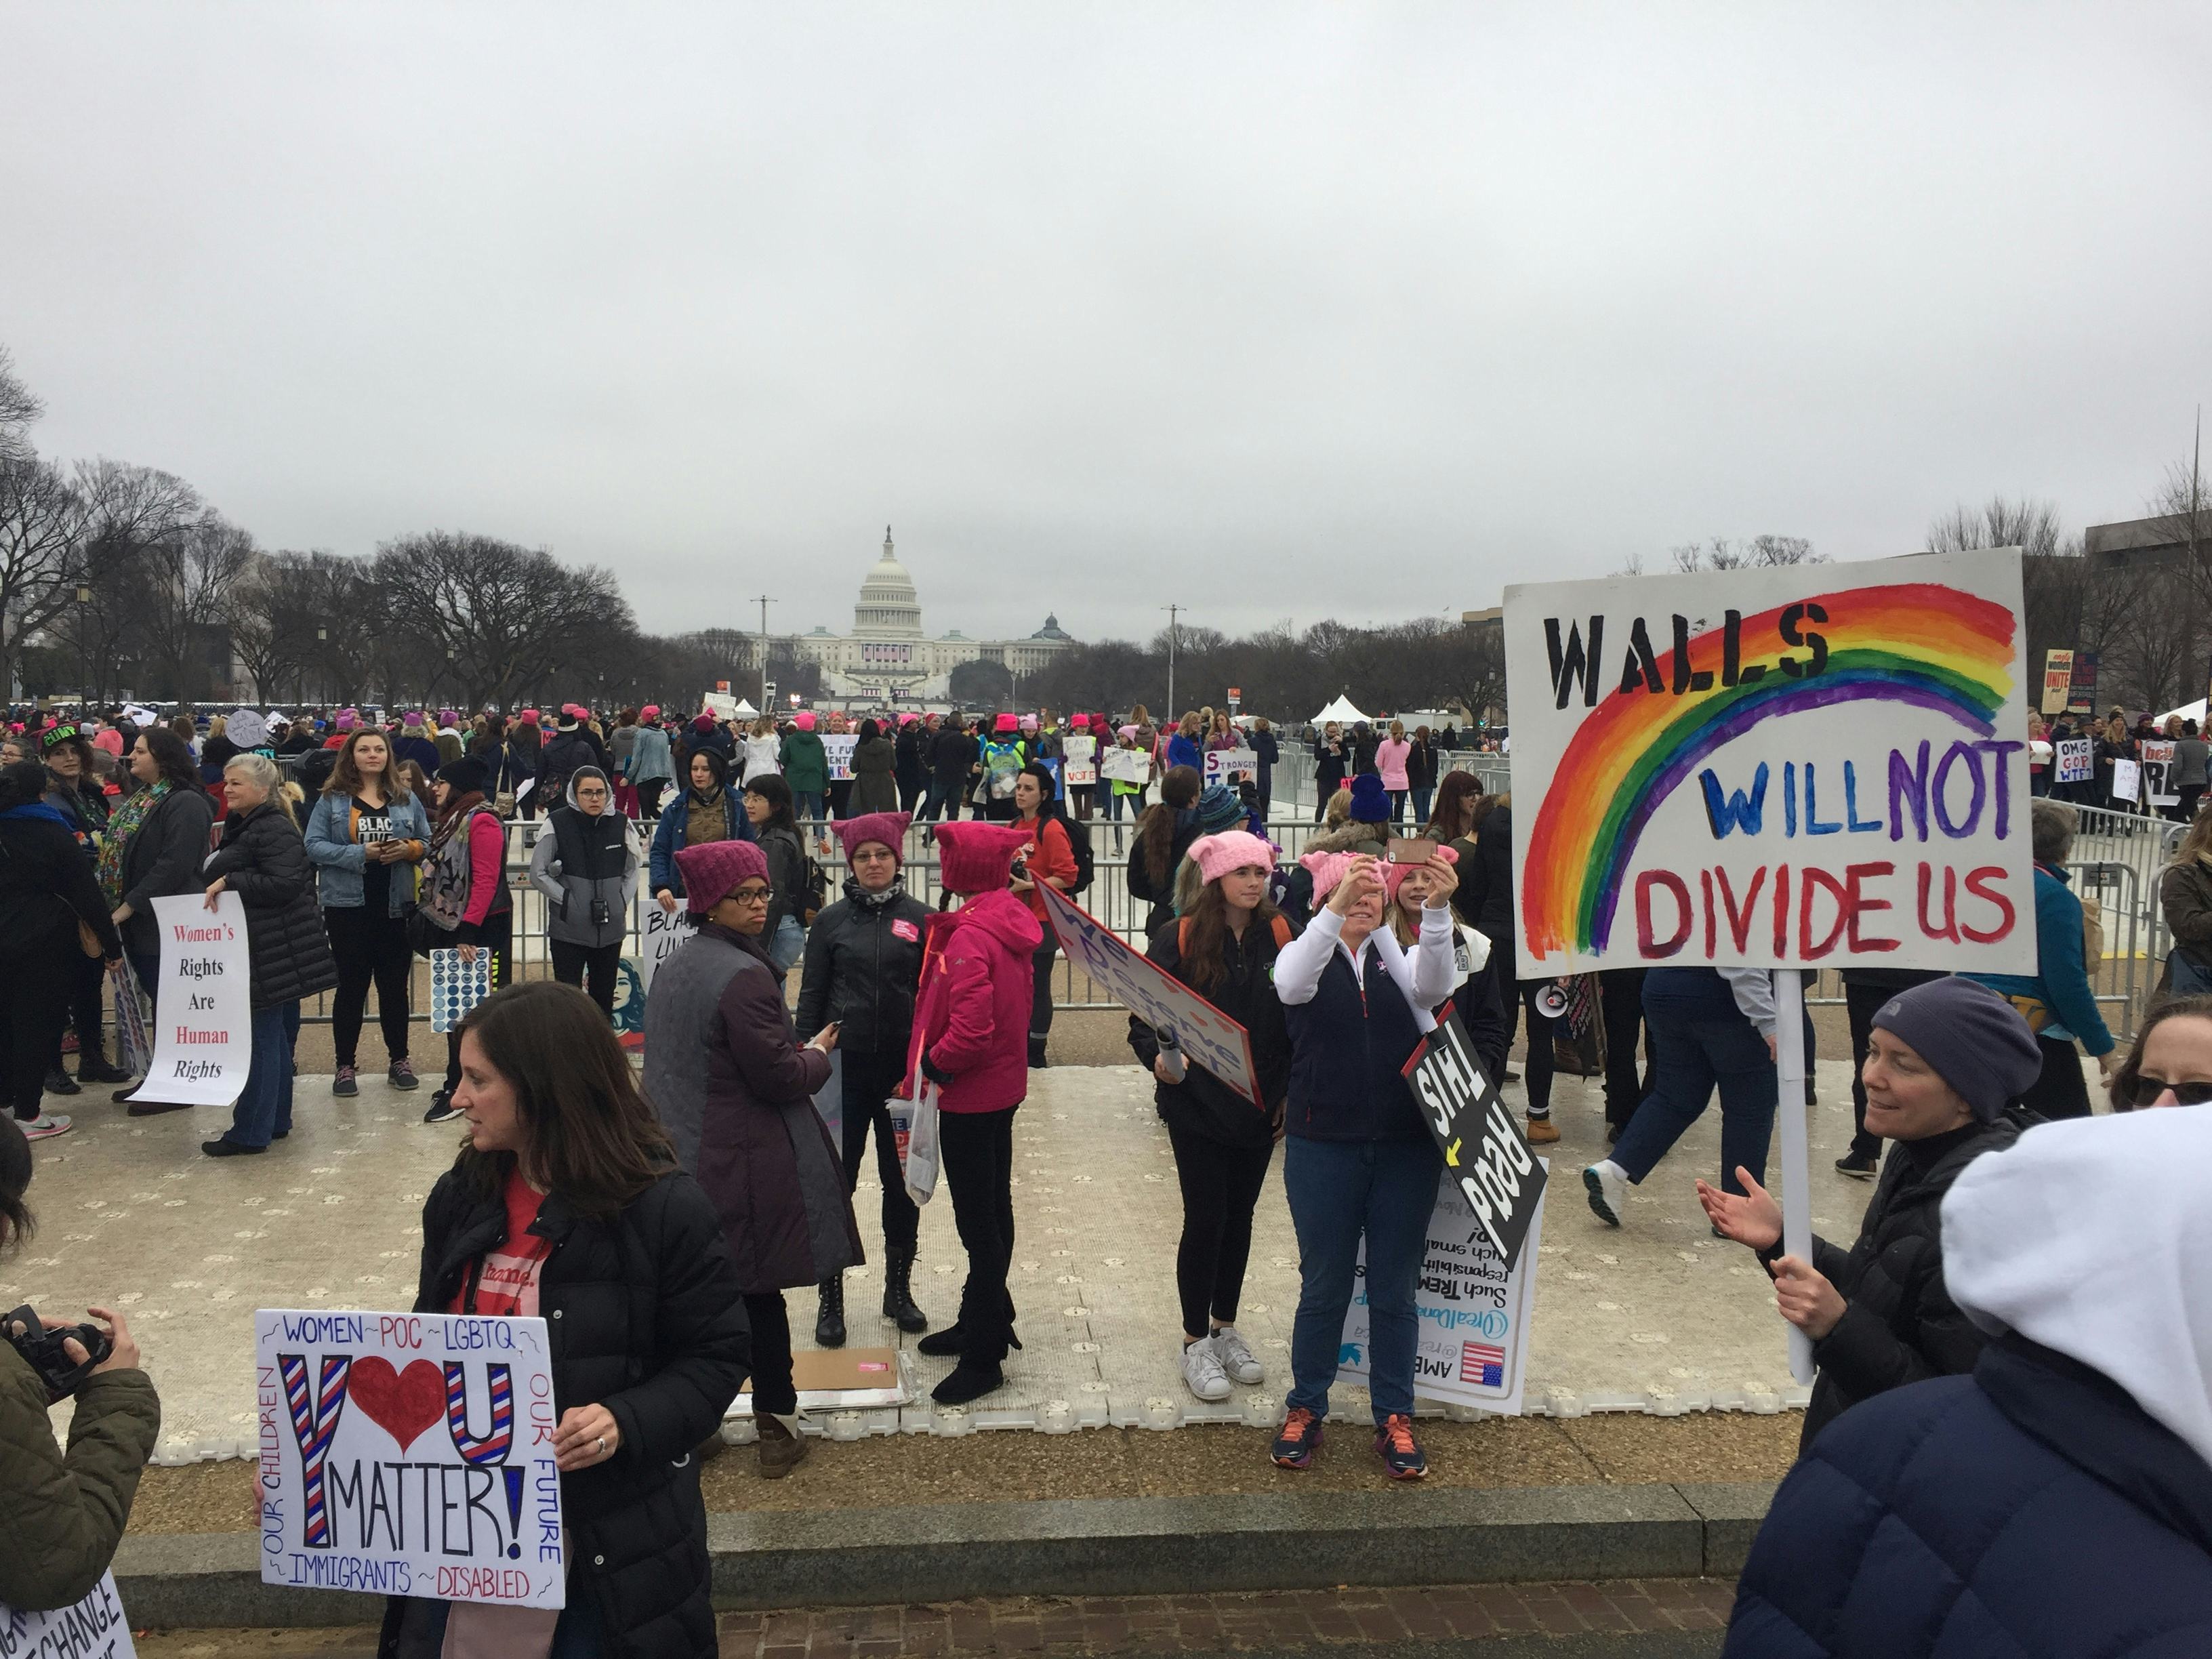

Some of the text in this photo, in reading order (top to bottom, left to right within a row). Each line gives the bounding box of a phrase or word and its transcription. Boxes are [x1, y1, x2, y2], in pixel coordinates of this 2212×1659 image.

[1544, 603, 1829, 710] WALLS
[2046, 671, 2070, 689] UNITE
[2060, 742, 2088, 756] OMG
[1207, 753, 1257, 771] STRONGER
[2060, 768, 2093, 781] WTF?
[2062, 756, 2089, 769] GOP
[1067, 771, 1095, 781] VOTE
[1698, 739, 2025, 842] WILL NOT
[358, 817, 393, 832] BLAC
[1635, 861, 2017, 961] DIVIDE US
[173, 922, 234, 943] Women's
[179, 957, 224, 982] Rights
[188, 992, 215, 1010] Are
[175, 1025, 229, 1046] Human
[172, 1058, 222, 1083] Rights
[1415, 1020, 1487, 1138] THIS
[1460, 1099, 1533, 1259] Read
[1463, 1282, 1507, 1309] Such
[283, 1315, 517, 1351] WOMEN POC LGBTQ
[259, 1365, 285, 1555] OUR CHILDREN
[529, 1372, 561, 1565] OUR FUTURE
[328, 1459, 526, 1561] MATTER!
[288, 1554, 530, 1599] IMMIGRANTS DISABLED
